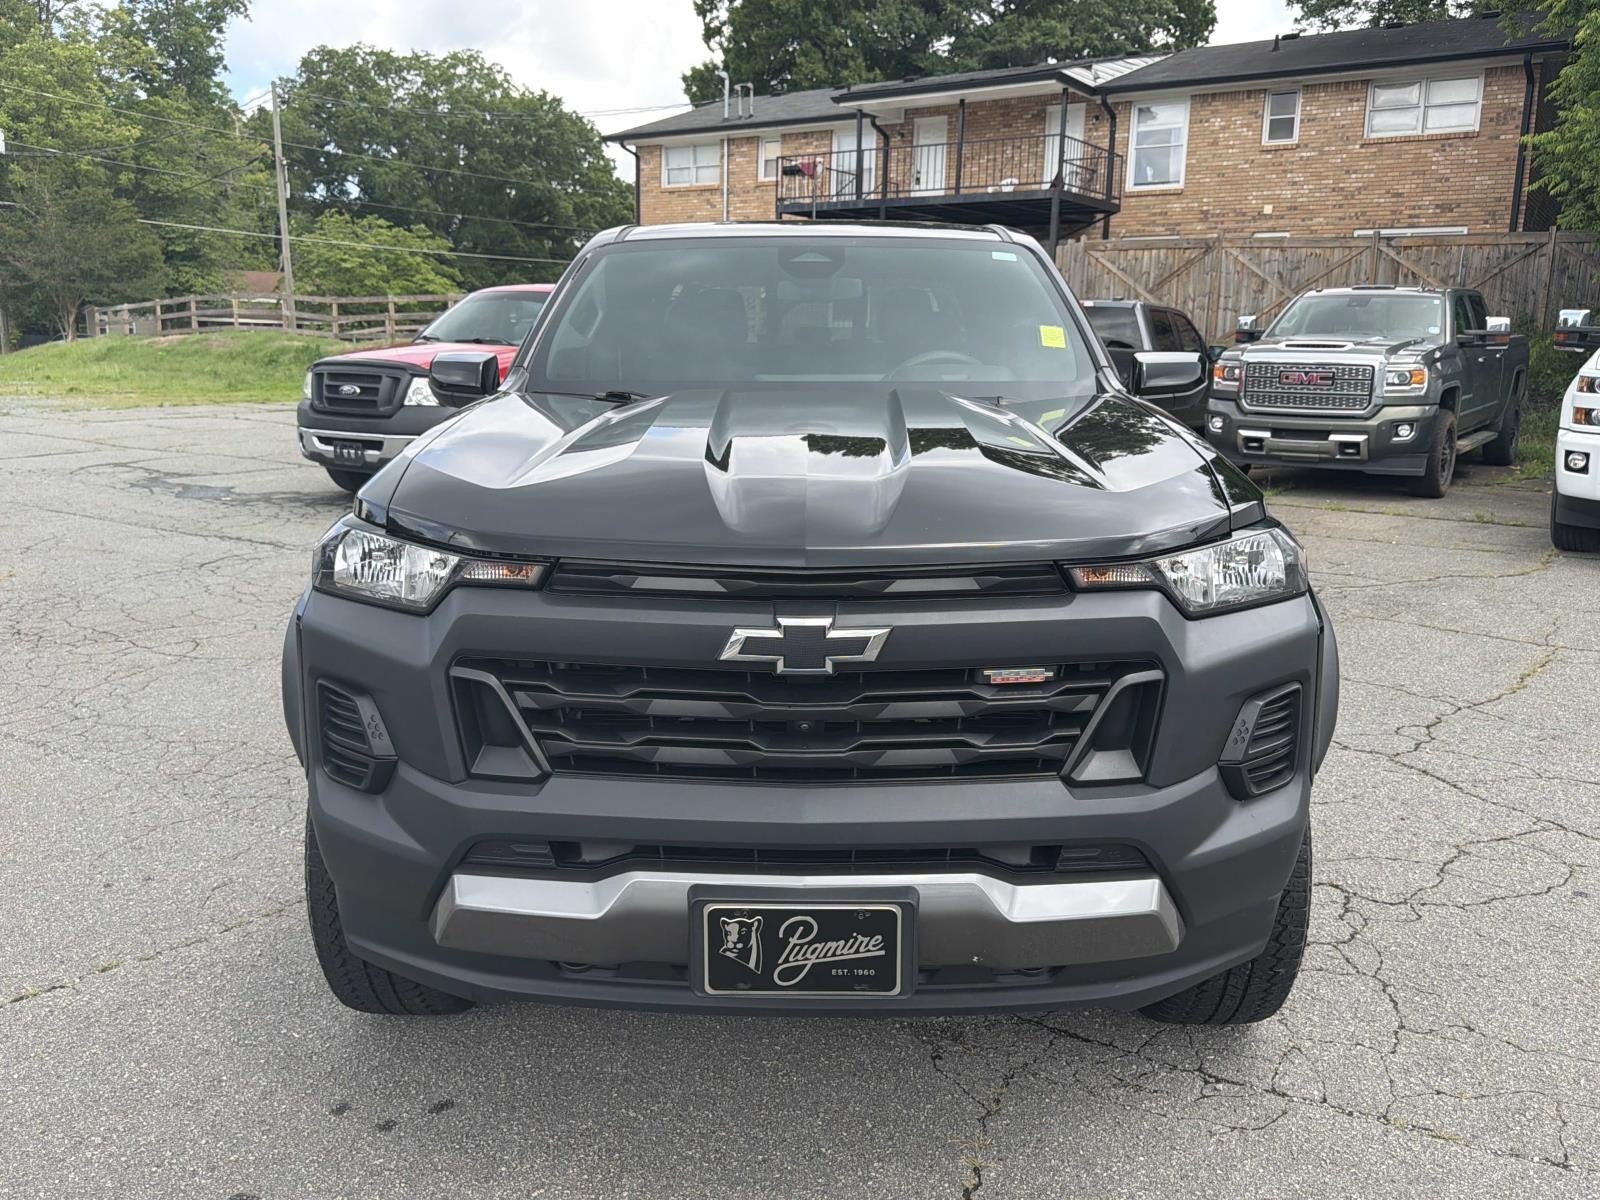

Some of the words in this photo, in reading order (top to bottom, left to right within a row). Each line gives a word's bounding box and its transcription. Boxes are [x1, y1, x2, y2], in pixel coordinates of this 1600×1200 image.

[1280, 371, 1333, 385] GMC
[773, 915, 886, 986] Pugmire
[831, 968, 850, 976] EST.
[854, 968, 876, 976] 1960
